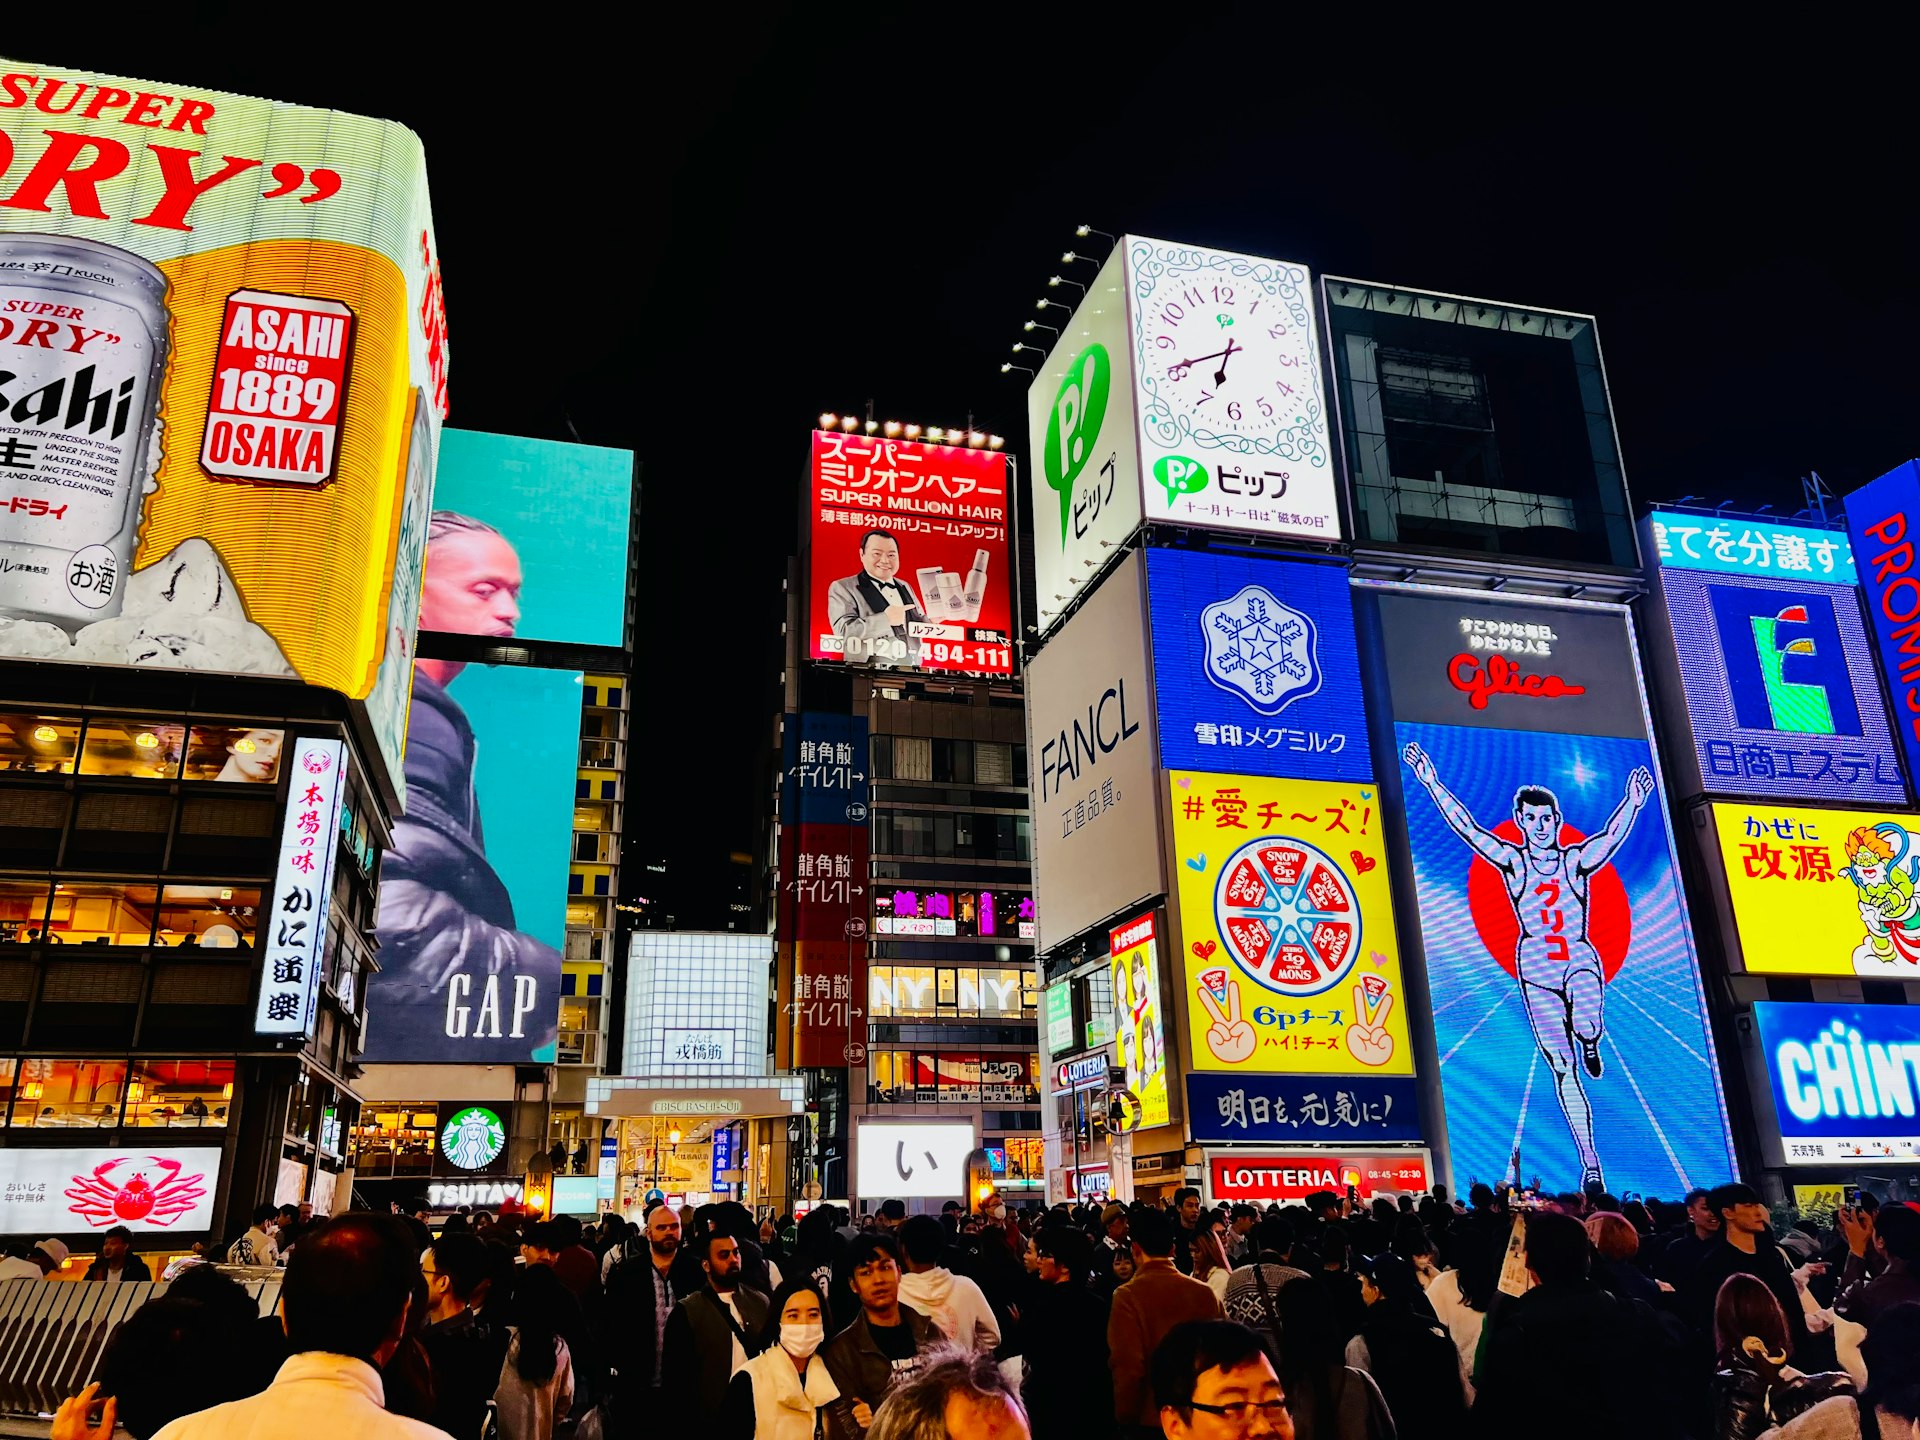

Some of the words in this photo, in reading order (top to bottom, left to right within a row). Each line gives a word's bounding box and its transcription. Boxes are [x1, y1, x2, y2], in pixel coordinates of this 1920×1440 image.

[0, 73, 215, 135] SUPER
[0, 128, 342, 232] RY”
[74, 270, 114, 284] KUCHI
[1183, 287, 1206, 308] 11
[1211, 285, 1235, 306] 12
[1249, 300, 1259, 315] 1
[3, 300, 84, 321] SUPER
[1160, 302, 1185, 327] 10
[225, 305, 345, 360] ASAHI
[1155, 335, 1176, 350] 9
[1268, 323, 1287, 340] 2
[254, 352, 309, 375] since
[1279, 354, 1298, 368] 3
[1167, 367, 1188, 382] 8
[219, 367, 336, 421] 1889
[1196, 389, 1215, 406] 7
[1276, 380, 1295, 397] 4
[1227, 401, 1242, 421] 6
[1256, 396, 1273, 417] 5
[23, 429, 46, 438] WITH
[49, 432, 93, 447] PRECISION
[209, 420, 324, 474] OSAKA
[42, 454, 81, 467] MASTER
[44, 443, 77, 455] UNDER
[79, 449, 96, 459] THE
[820, 437, 923, 467] スーパー
[4, 472, 28, 481] AND
[62, 480, 90, 492] CLEAN
[40, 464, 60, 474] ING
[62, 469, 116, 487] TECHNIQUES
[820, 461, 1003, 499] ミリオンヘアー
[1217, 465, 1290, 499] ピップ
[820, 488, 882, 508] SUPER
[887, 496, 954, 516] MILLION
[958, 505, 1003, 521] HAIR
[1073, 451, 1117, 540] ピップ
[820, 509, 1005, 541] 薄毛部分のボリュームアップ!
[70, 560, 116, 597] お酒
[912, 624, 946, 637] ルアン
[1459, 617, 1558, 641] すこやかな毎日、
[847, 636, 1010, 668] 0120-494-111
[1470, 634, 1552, 655] ゆたかな人生
[1447, 653, 1586, 710] Glico
[1041, 677, 1140, 804] FANCL
[1194, 722, 1346, 754] 雪印メグミルク
[800, 740, 855, 765] 龍角散
[1705, 739, 1905, 785] 日商エステム
[788, 765, 851, 790] ダイレクト
[1061, 776, 1122, 839] 正直品質。
[291, 782, 325, 875] 本場の味
[1743, 815, 1819, 841] かぜに
[798, 853, 854, 878] 龍角散
[1267, 851, 1299, 863] SNOW
[1739, 842, 1836, 883] 改源
[786, 880, 850, 904] ダイレクト
[1228, 864, 1250, 900] SNOW
[1318, 871, 1346, 906] SNOW
[1534, 878, 1570, 961] グリコ
[267, 885, 313, 1021] かに道楽
[1230, 924, 1258, 960] SNOW
[1328, 929, 1349, 966] SNOW
[794, 973, 853, 1000] 龍角散
[1278, 969, 1312, 980] SNOW
[445, 973, 537, 1038] GAP
[872, 976, 931, 1009] NY
[959, 977, 1016, 1010] NY
[783, 1002, 849, 1027] ダイレクト
[685, 1033, 713, 1044] なんば
[675, 1044, 722, 1060] 戎橋筋
[1068, 1054, 1107, 1081] LOTTERIA
[654, 1102, 684, 1112] EBISU
[896, 1140, 939, 1182] い
[1791, 1144, 1825, 1157] 天気予報
[6, 1182, 47, 1192] おいしさ
[1223, 1169, 1338, 1187] LOTTERIA
[4, 1193, 46, 1203] 年中無休
